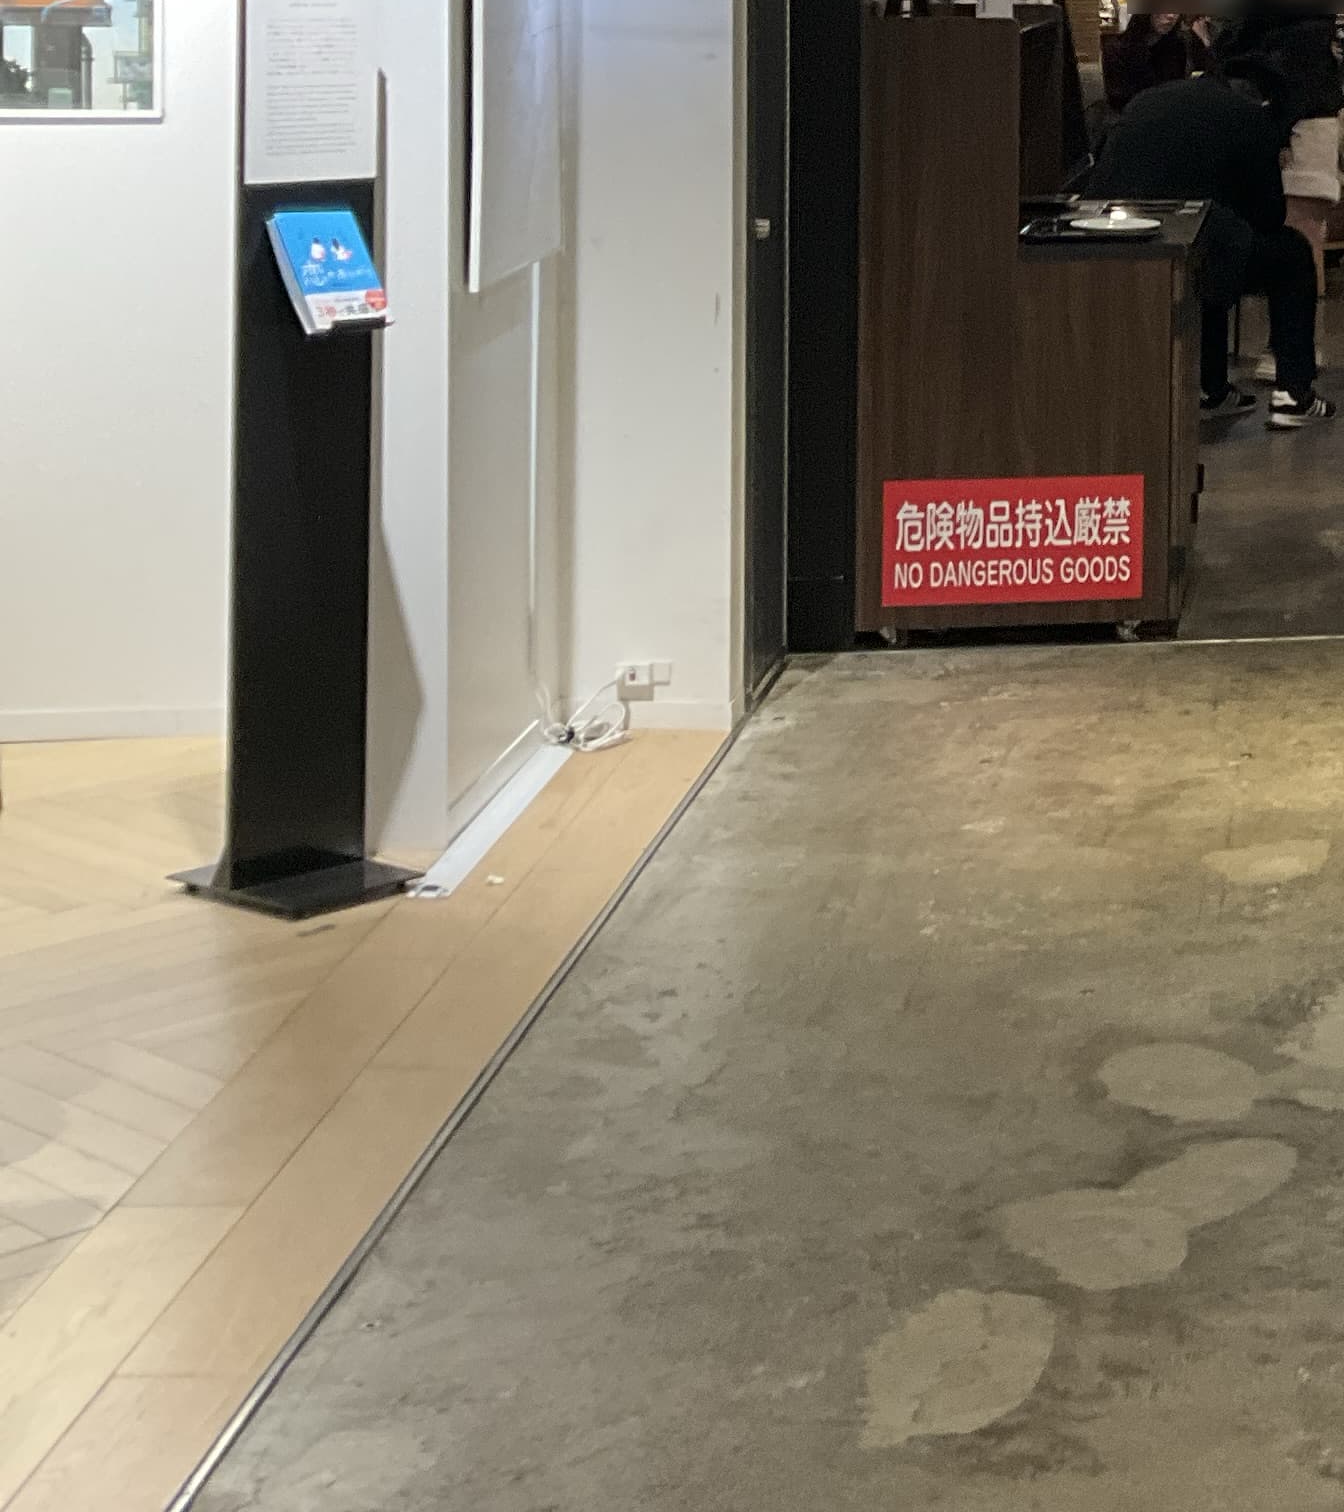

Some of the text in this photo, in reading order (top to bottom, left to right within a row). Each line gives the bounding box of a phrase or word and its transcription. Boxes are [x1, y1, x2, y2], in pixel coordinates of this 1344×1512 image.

[895, 496, 1131, 552] 危険物品持込厳禁
[894, 555, 1131, 590] NO DANGEROUS GOODS
